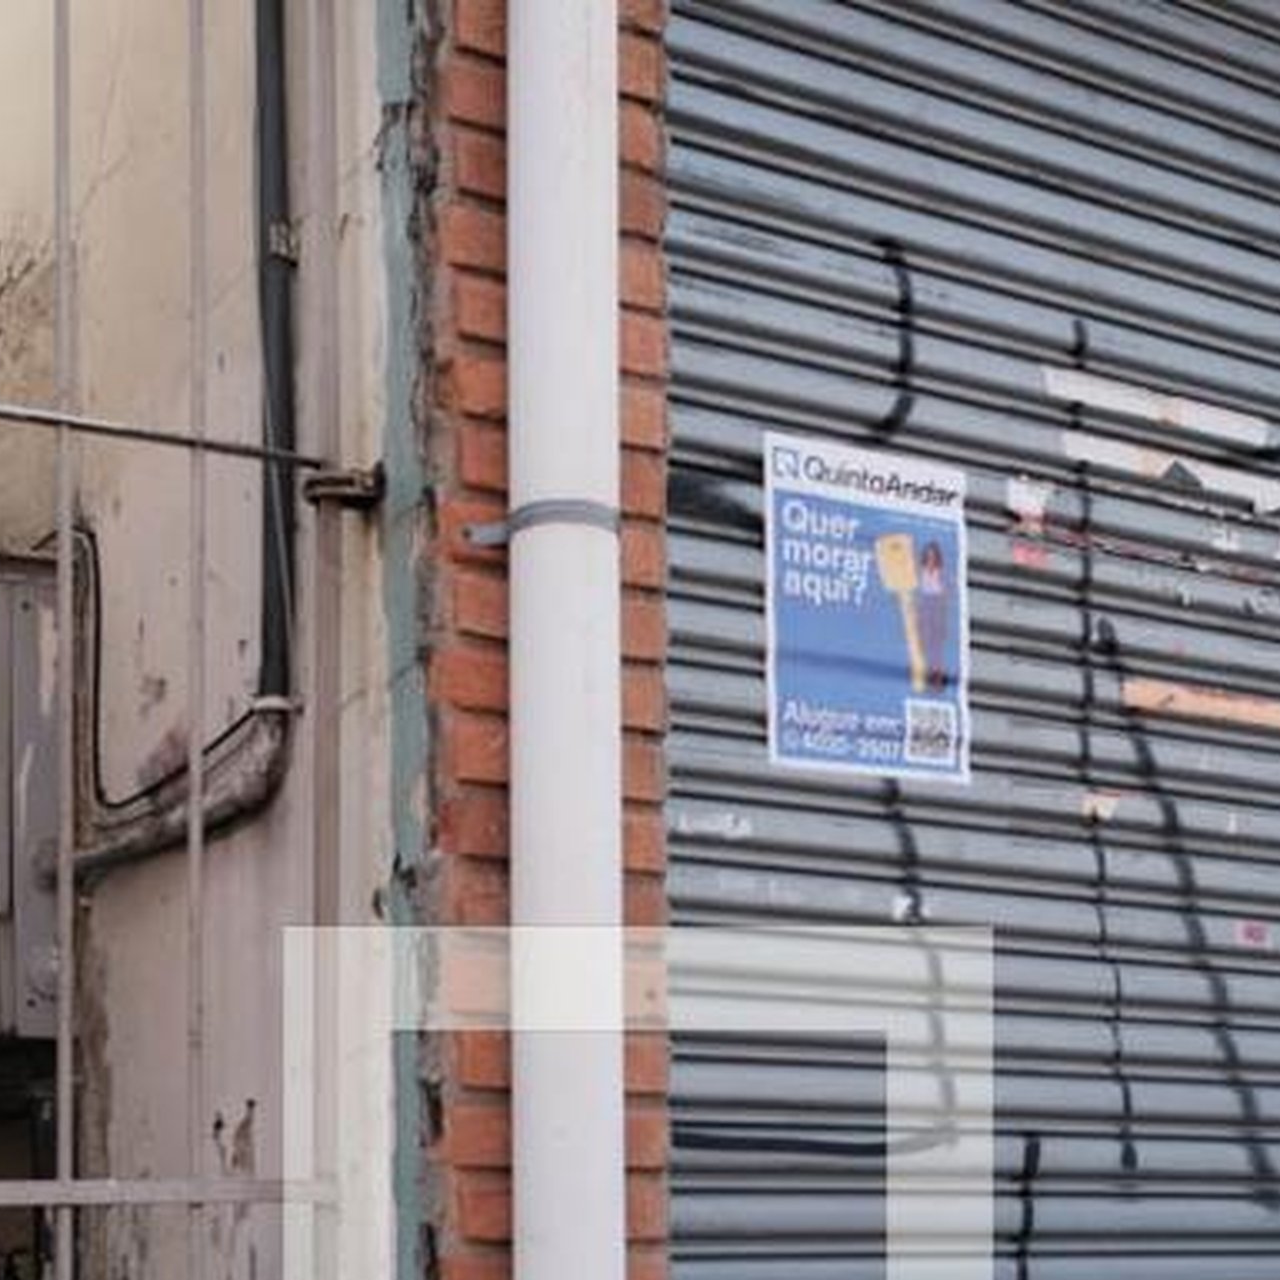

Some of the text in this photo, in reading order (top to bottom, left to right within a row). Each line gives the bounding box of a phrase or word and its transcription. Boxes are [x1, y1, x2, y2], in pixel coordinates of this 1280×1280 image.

[805, 456, 958, 506] QuintoAndar
[783, 502, 859, 540] Quer
[783, 541, 873, 575] morar
[783, 572, 866, 605] aqui?
